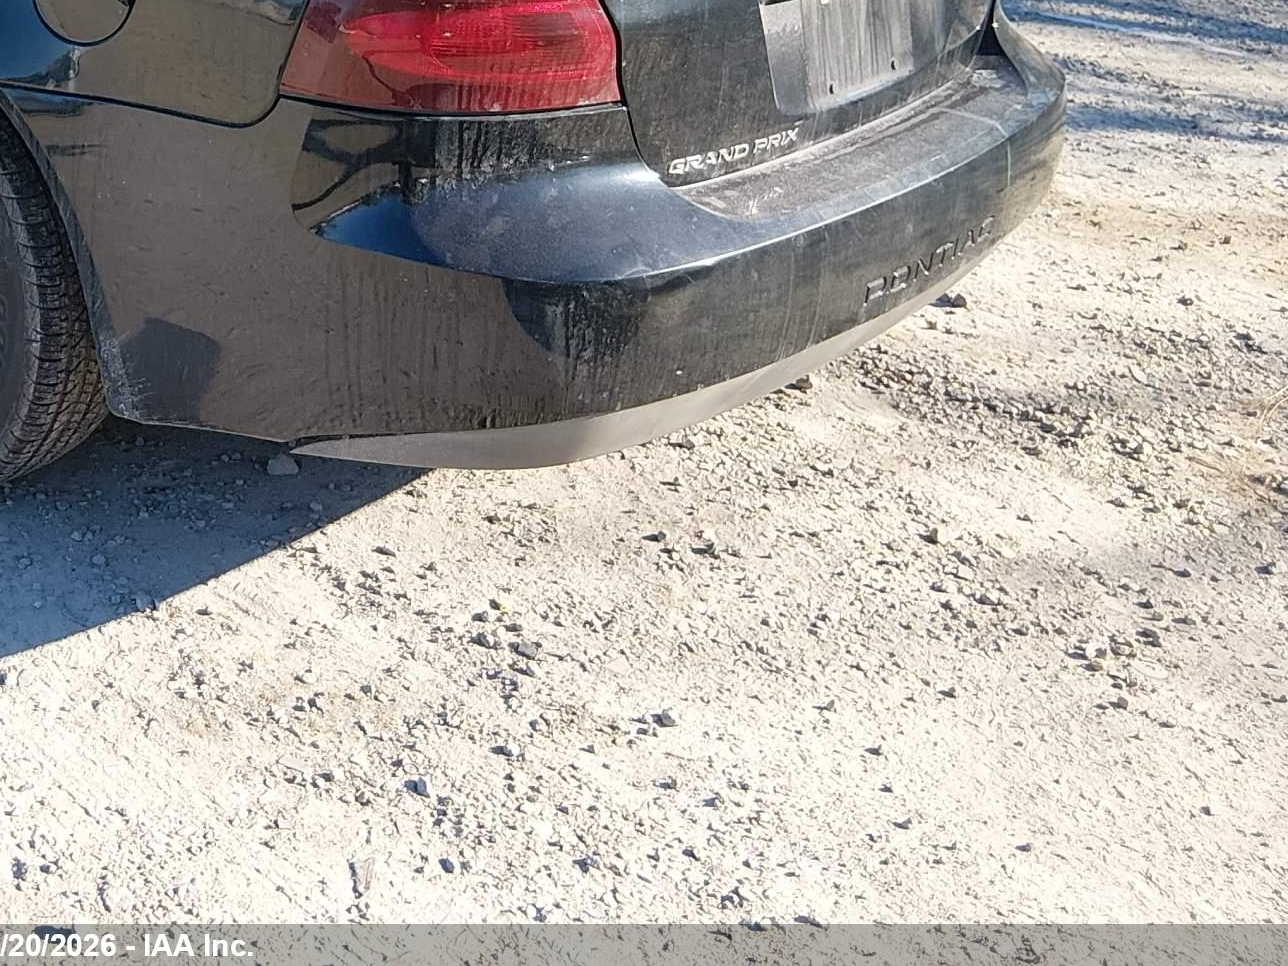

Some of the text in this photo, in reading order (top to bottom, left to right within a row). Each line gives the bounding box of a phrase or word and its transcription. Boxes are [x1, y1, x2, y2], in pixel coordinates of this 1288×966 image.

[668, 127, 800, 174] GRAND PRIX
[863, 214, 996, 307] PONTIAC
